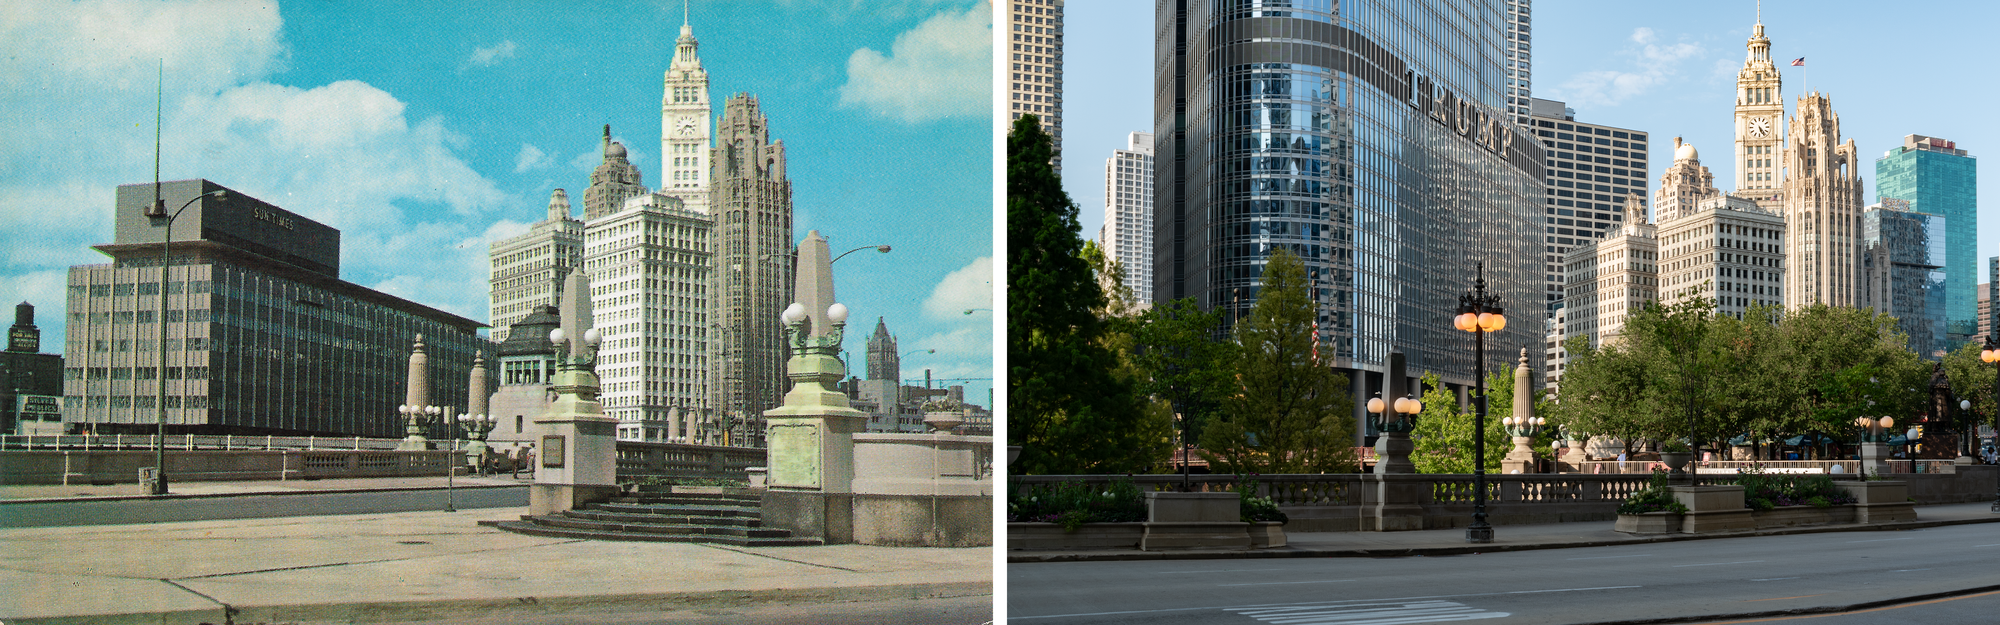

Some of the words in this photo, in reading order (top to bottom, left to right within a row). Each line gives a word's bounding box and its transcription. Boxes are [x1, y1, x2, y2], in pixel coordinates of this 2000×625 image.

[1405, 62, 1512, 161] TRUMP
[254, 207, 269, 220] SUN
[271, 212, 294, 231] TIMES
